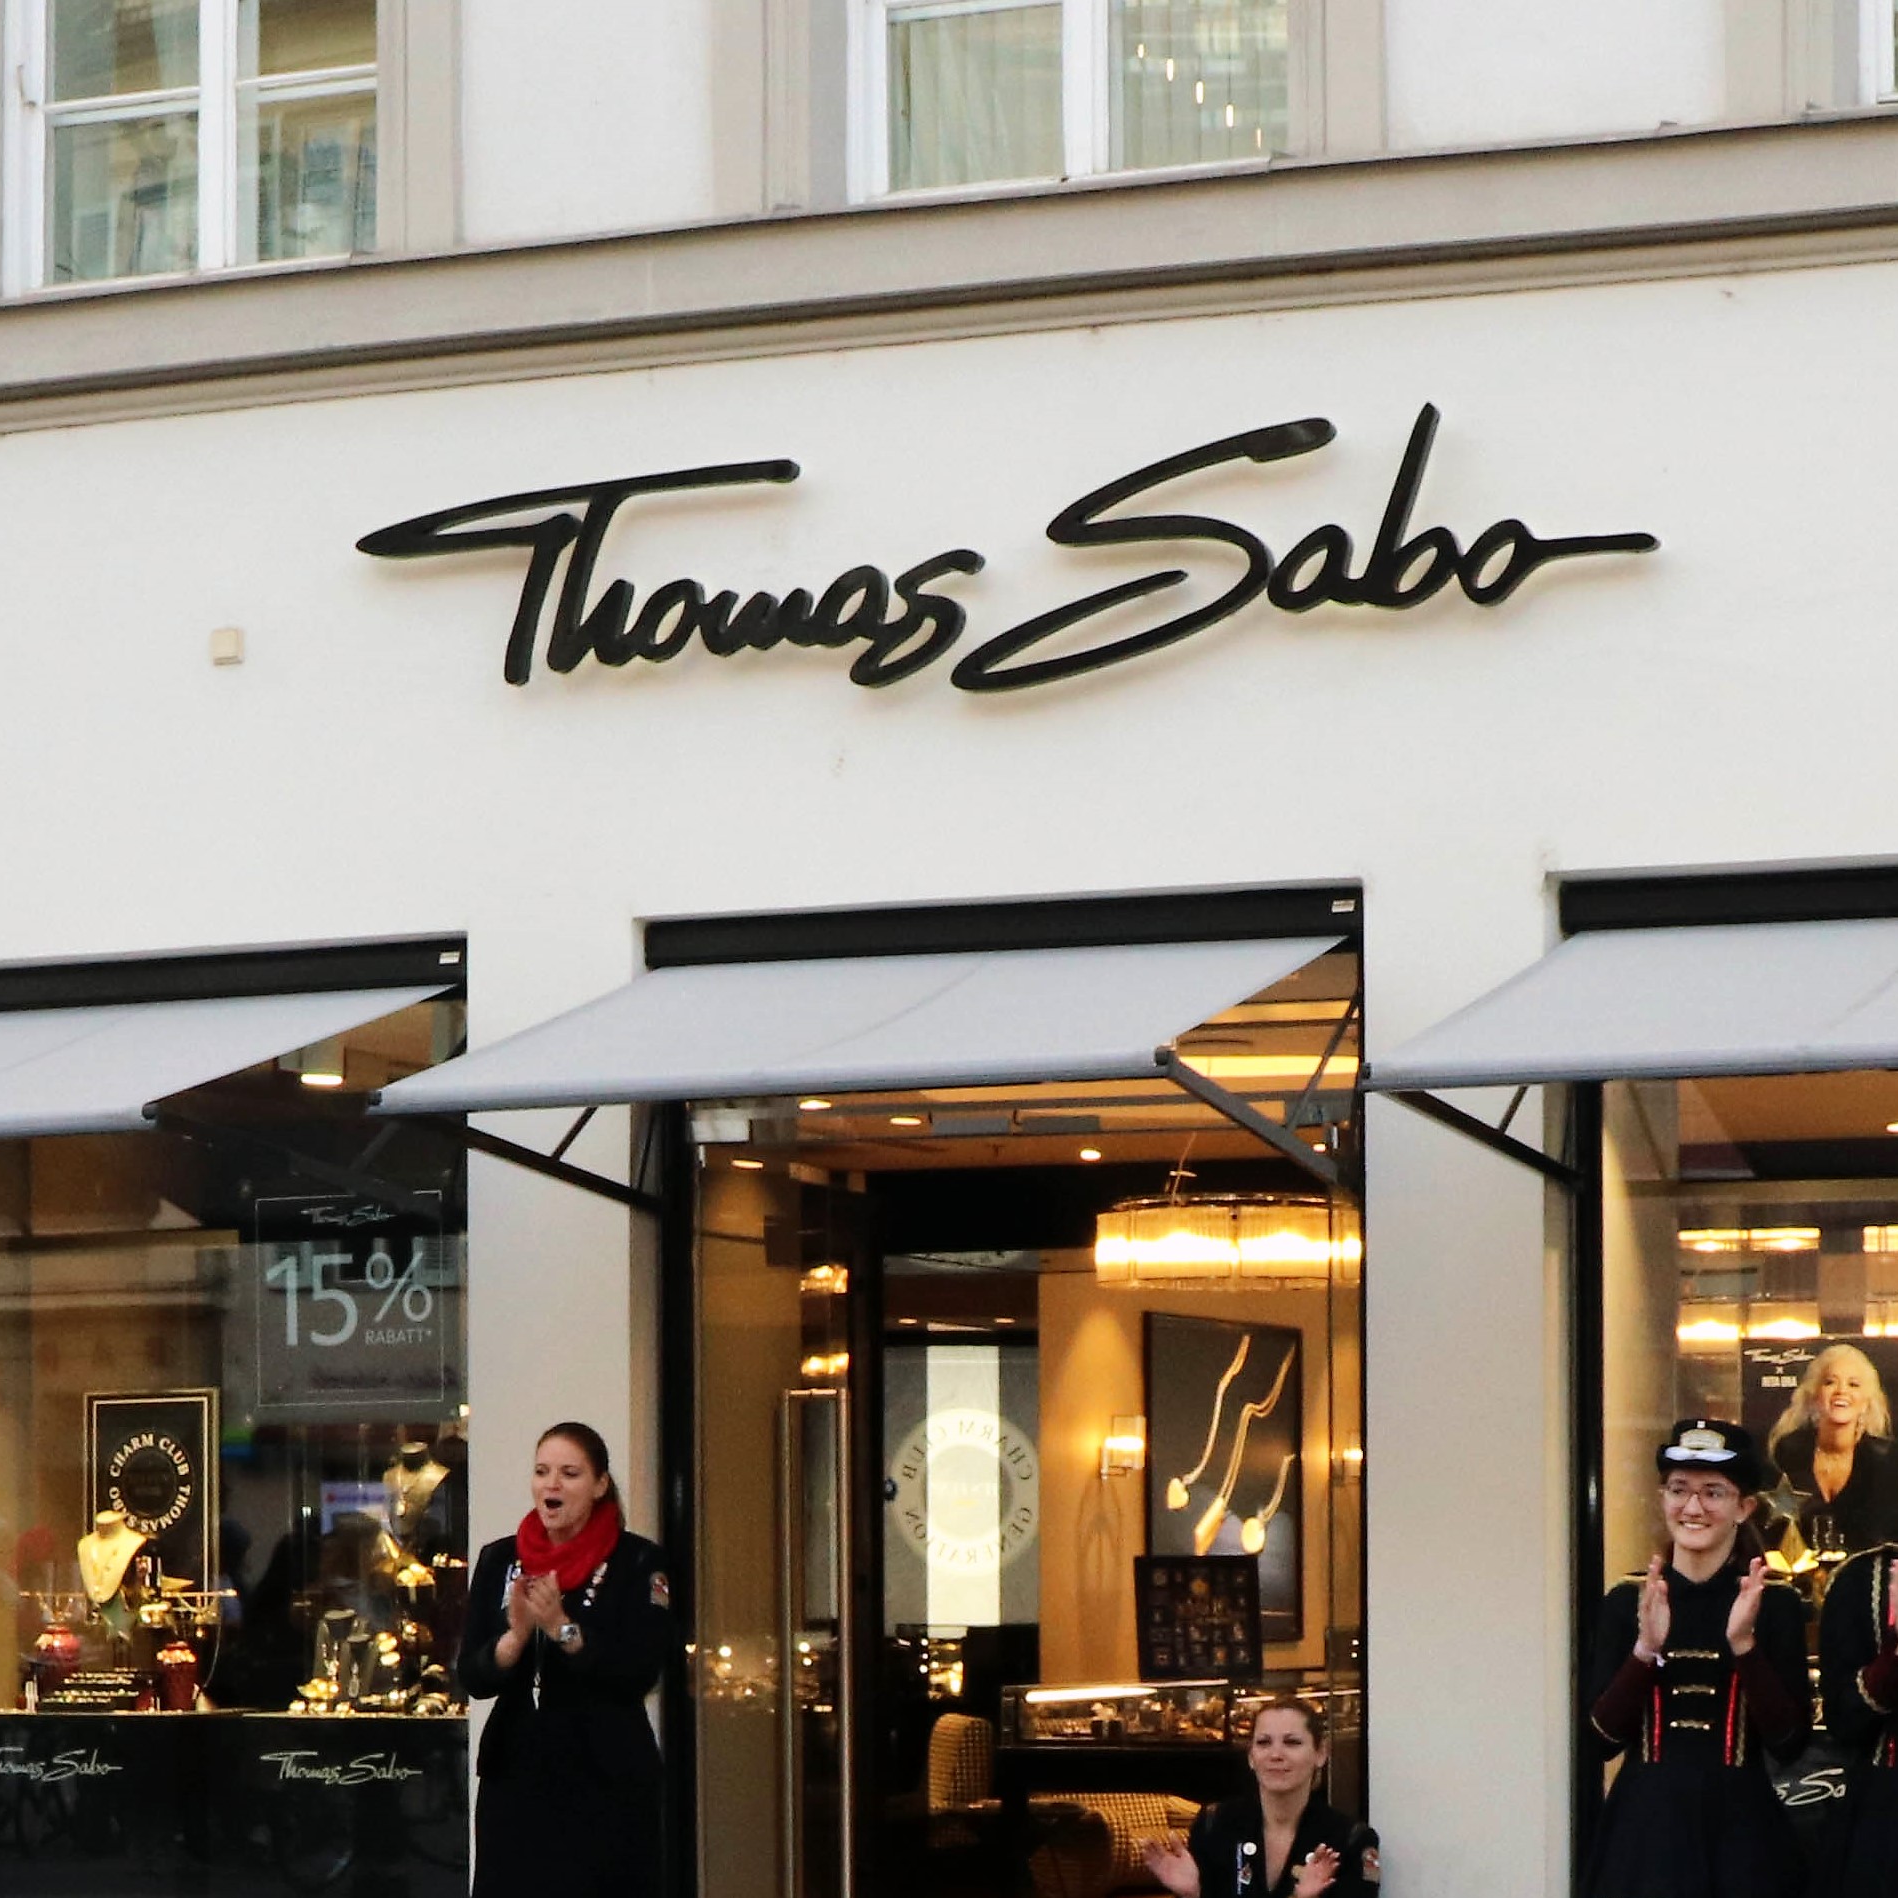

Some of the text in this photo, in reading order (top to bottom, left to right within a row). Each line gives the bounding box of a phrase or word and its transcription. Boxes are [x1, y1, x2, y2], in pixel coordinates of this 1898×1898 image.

[355, 401, 1660, 692] Thomas Sabo
[266, 1251, 434, 1346] 15%
[109, 1433, 190, 1478] CHARM CLUB
[41, 1748, 124, 1782] Sabo
[260, 1750, 423, 1785] Thomas Sabo
[1784, 1767, 1846, 1806] Sa
